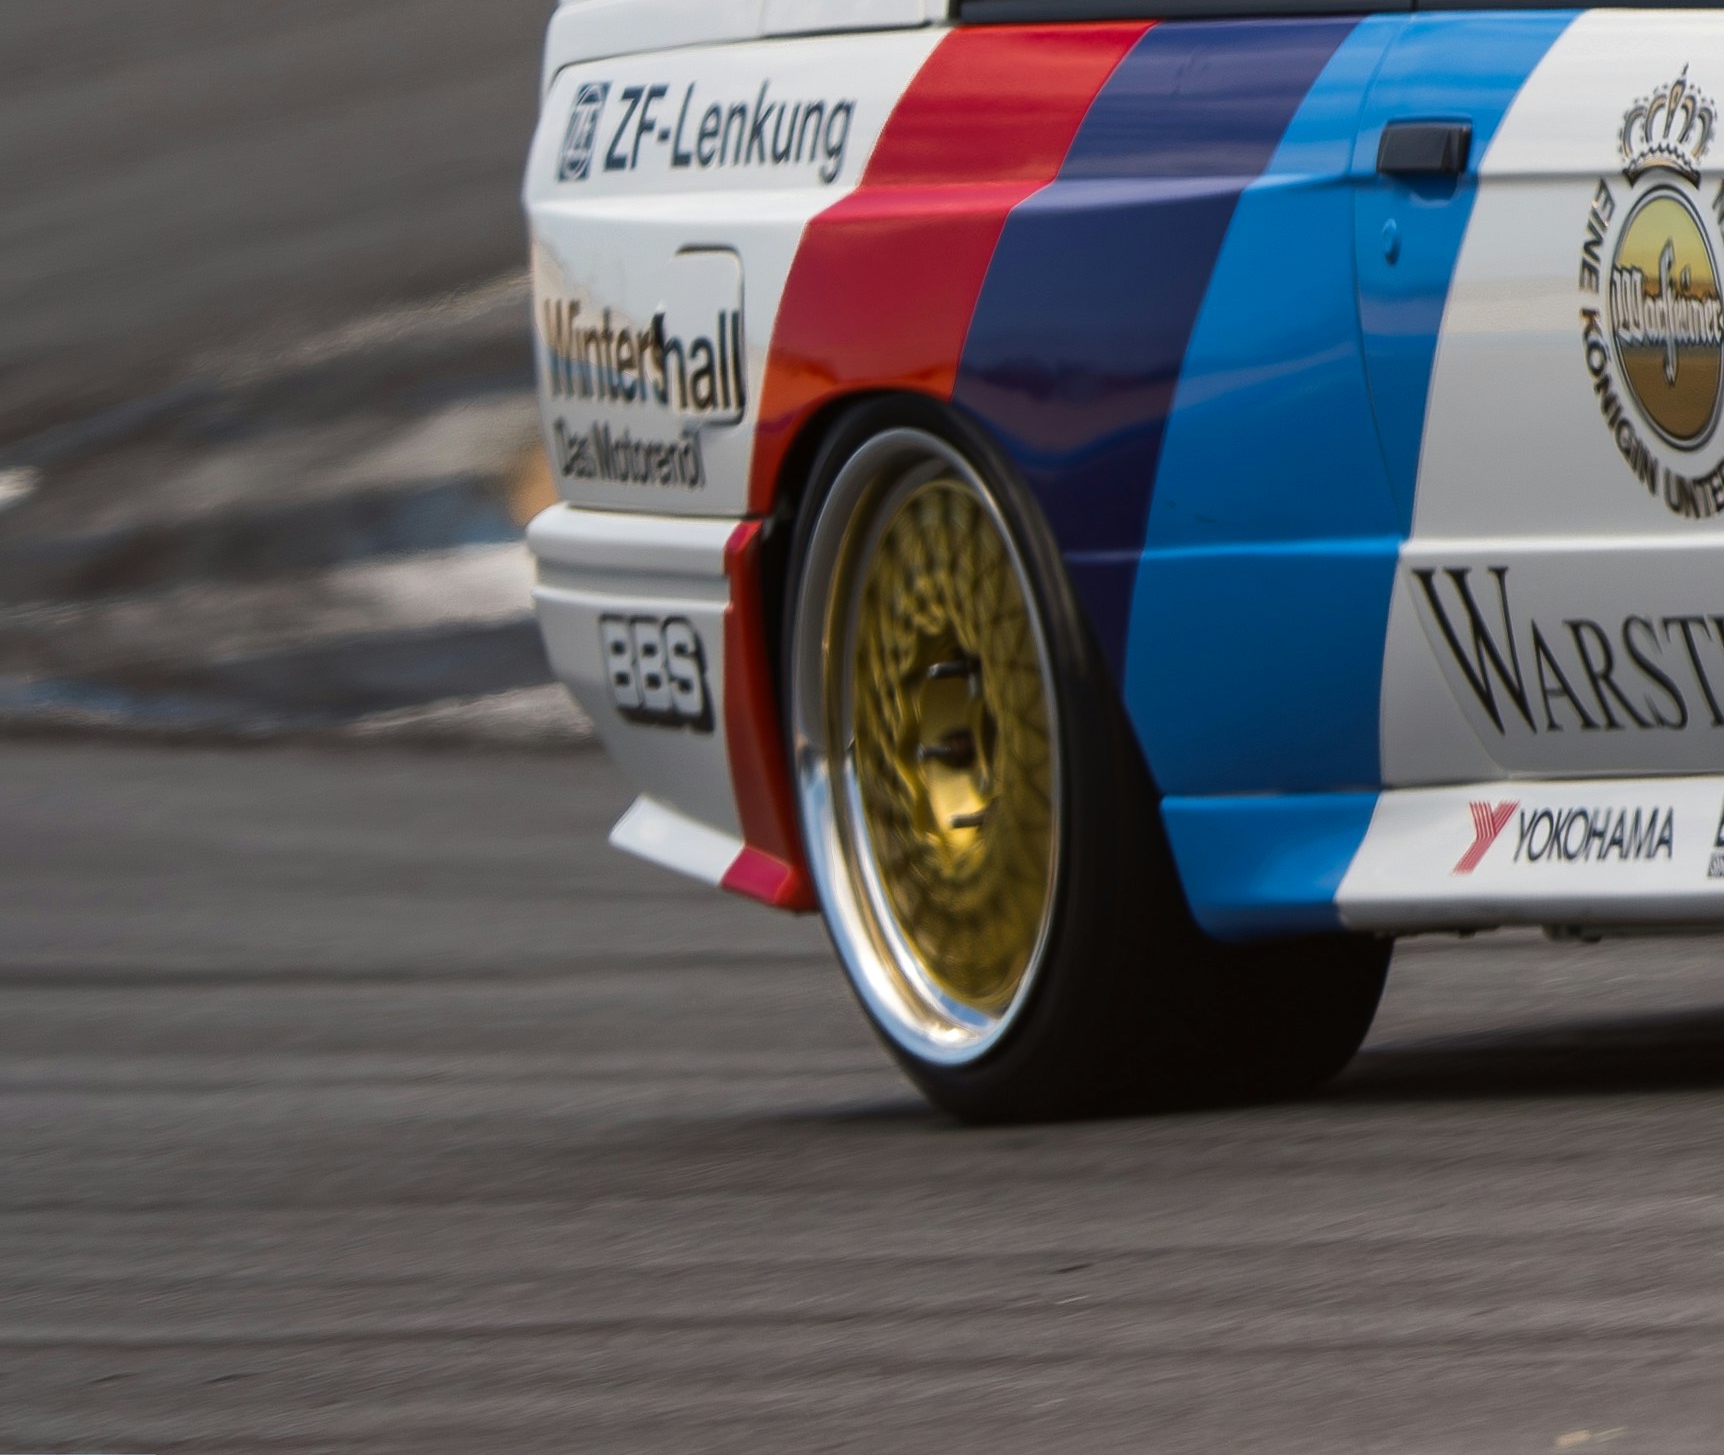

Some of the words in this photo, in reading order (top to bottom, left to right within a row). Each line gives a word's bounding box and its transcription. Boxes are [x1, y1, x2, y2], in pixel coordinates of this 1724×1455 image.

[603, 78, 857, 184] ZF-Lenkung
[599, 613, 715, 733] BBS
[1512, 805, 1675, 864] YOKOHAMA
